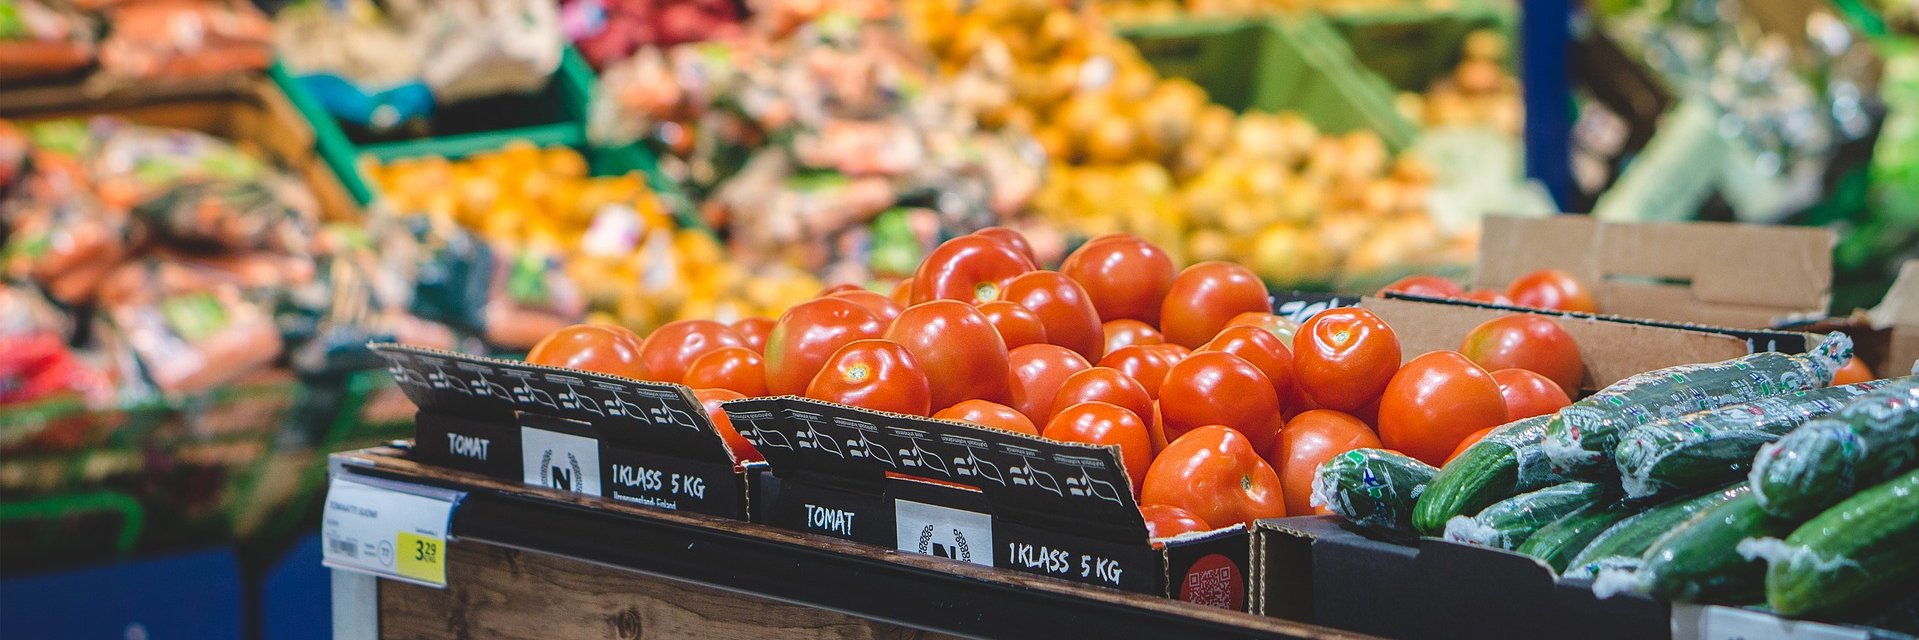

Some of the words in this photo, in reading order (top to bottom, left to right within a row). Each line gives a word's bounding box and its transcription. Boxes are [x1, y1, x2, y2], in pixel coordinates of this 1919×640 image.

[447, 432, 490, 461] TOMAT
[551, 465, 571, 491] N
[612, 464, 618, 484] 1
[619, 464, 662, 491] KLASS
[671, 473, 680, 494] 5
[683, 475, 706, 500] KG
[804, 504, 855, 537] TOMAT
[1009, 542, 1015, 564] 1
[1018, 543, 1070, 574] KLASS
[1081, 555, 1091, 578] 5
[1096, 556, 1123, 586] KG
